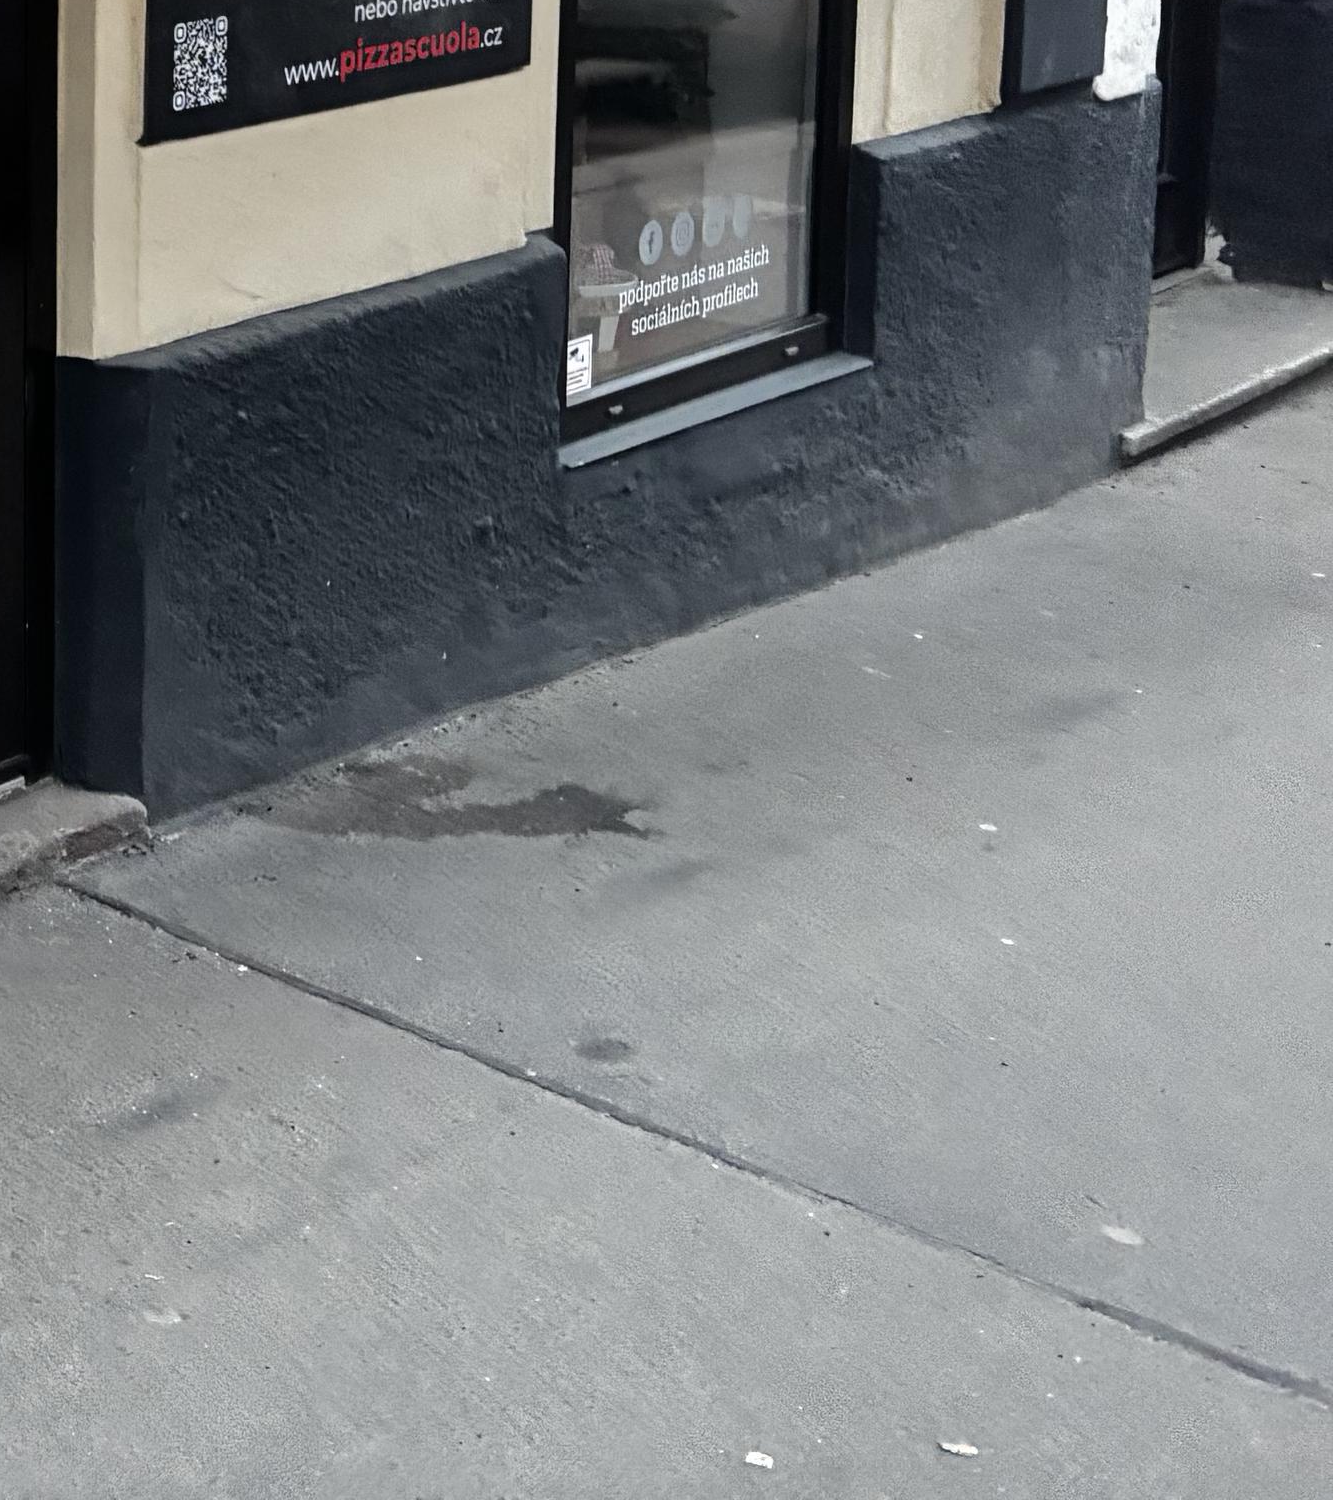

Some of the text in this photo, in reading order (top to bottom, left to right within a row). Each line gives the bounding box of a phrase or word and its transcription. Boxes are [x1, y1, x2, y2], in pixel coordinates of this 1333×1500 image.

[285, 20, 502, 85] www.pizzascuola.cz
[619, 244, 769, 313] podpořte nás na našich
[631, 278, 758, 336] sociálních profilech
